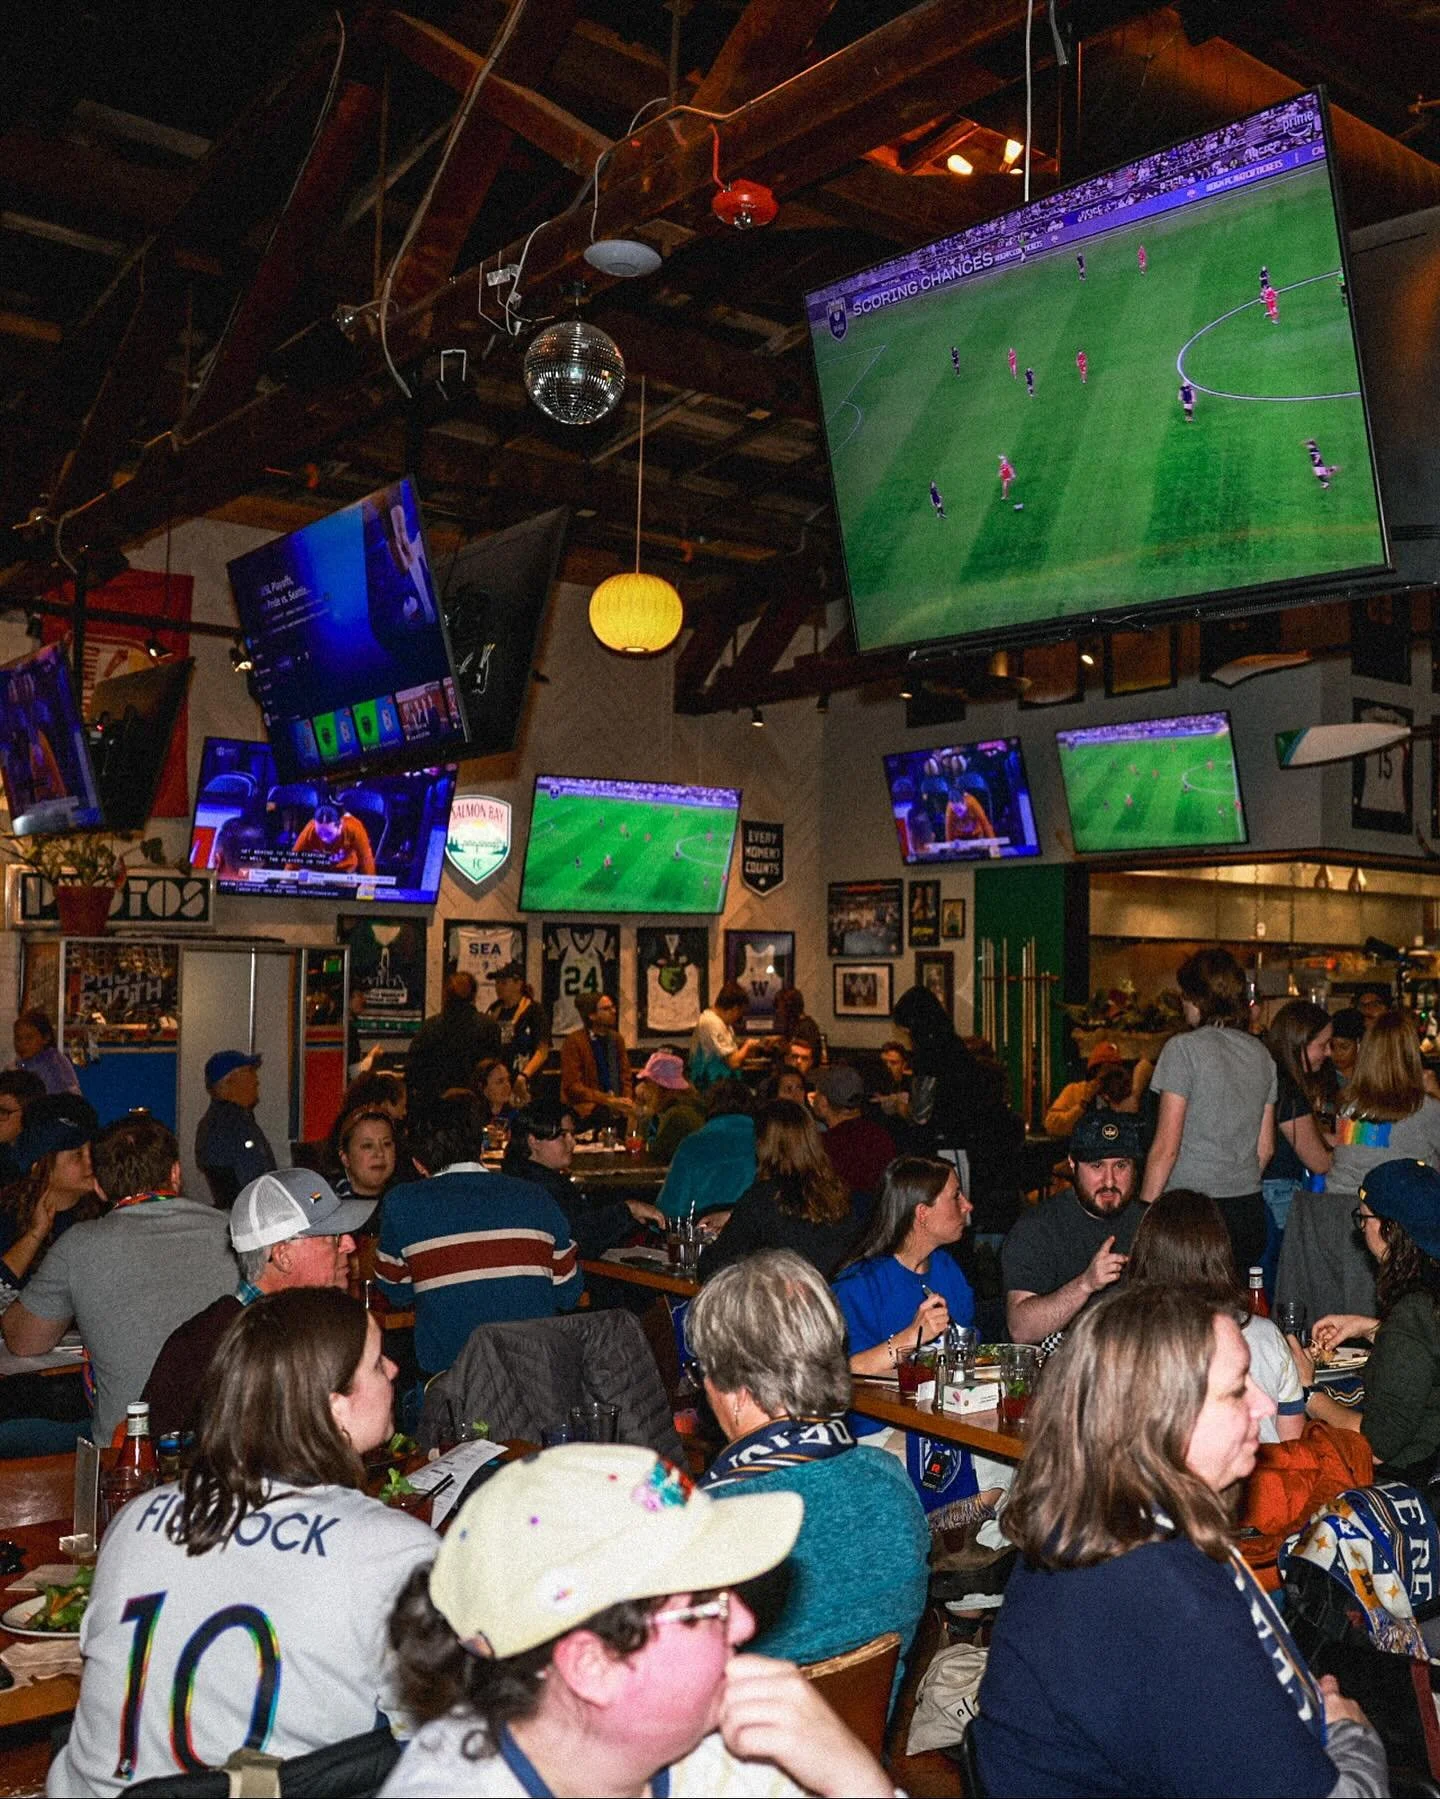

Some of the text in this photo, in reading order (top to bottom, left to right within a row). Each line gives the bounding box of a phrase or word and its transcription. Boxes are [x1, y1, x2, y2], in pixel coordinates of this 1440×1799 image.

[1282, 110, 1314, 133] prime
[852, 252, 994, 317] SCORING CHANCES
[488, 805, 505, 824] BAY
[748, 829, 777, 845] EVERY
[745, 860, 780, 877] COUNTS
[25, 877, 205, 917] PTOS
[468, 942, 502, 956] SEA
[80, 971, 161, 991] PHOT
[564, 965, 600, 996] 24
[750, 980, 769, 997] W
[136, 1493, 340, 1557] FIOCK
[112, 1590, 282, 1780] 10
